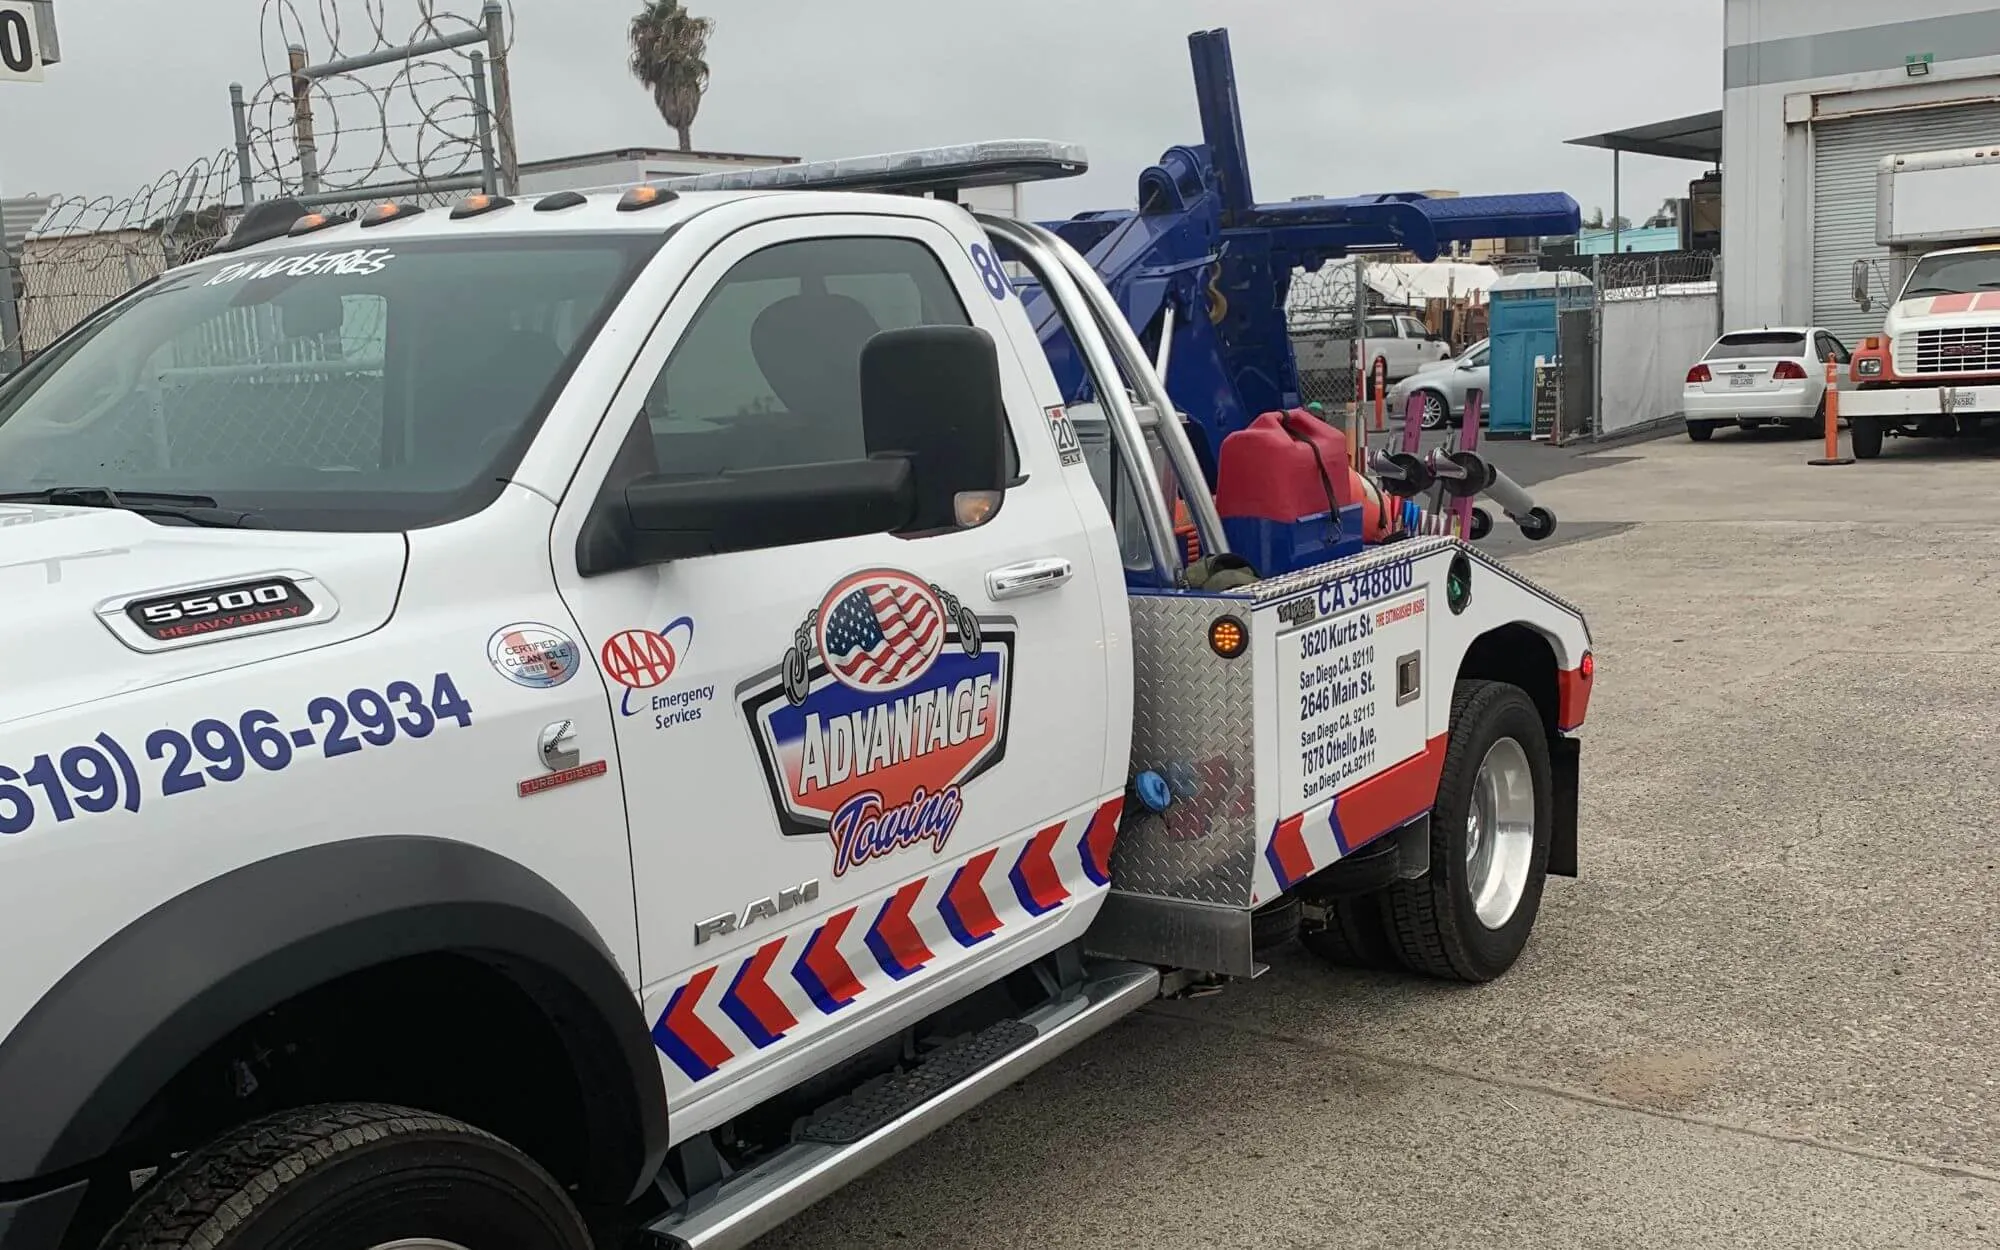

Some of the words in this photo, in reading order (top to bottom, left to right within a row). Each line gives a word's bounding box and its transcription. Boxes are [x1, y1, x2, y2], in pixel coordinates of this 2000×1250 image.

[1052, 417, 1075, 449] 20
[144, 585, 288, 623] 5500
[1318, 581, 1346, 616] CA
[1348, 559, 1413, 606] 348800
[158, 615, 236, 639] HEAVY
[239, 605, 300, 623] DUTY
[1300, 627, 1328, 660] 3620
[1329, 620, 1357, 650] Kurtz
[1359, 612, 1374, 638] St.
[504, 639, 558, 656] CERTIFIED
[505, 653, 542, 667] CLEAN
[543, 648, 569, 660] IDLE
[603, 630, 675, 688] AAA
[1300, 671, 1315, 690] San
[1316, 664, 1337, 684] Diego
[1338, 655, 1352, 675] CA.
[1352, 645, 1374, 670] 92110
[652, 683, 715, 711] Emergency
[655, 707, 702, 730] Services
[1300, 687, 1330, 721] 2646
[1331, 677, 1358, 708] Main
[1360, 671, 1376, 695] St.
[145, 672, 473, 797] 296-2934
[544, 719, 572, 754] Cummins
[798, 673, 993, 797] ADVANTAGE
[1301, 731, 1316, 747] San
[1317, 722, 1339, 741] Diego
[1339, 712, 1353, 730] CA.
[1353, 701, 1375, 724] 92113
[1302, 743, 1325, 777] 7878
[1326, 731, 1357, 765] Othello
[1358, 726, 1377, 750] Ave.
[521, 773, 564, 795] TURBO
[564, 762, 606, 783] DIESEL
[1303, 783, 1318, 799] San
[1319, 771, 1340, 791] Diego
[829, 783, 963, 878] Towing
[694, 878, 819, 947] RAM
